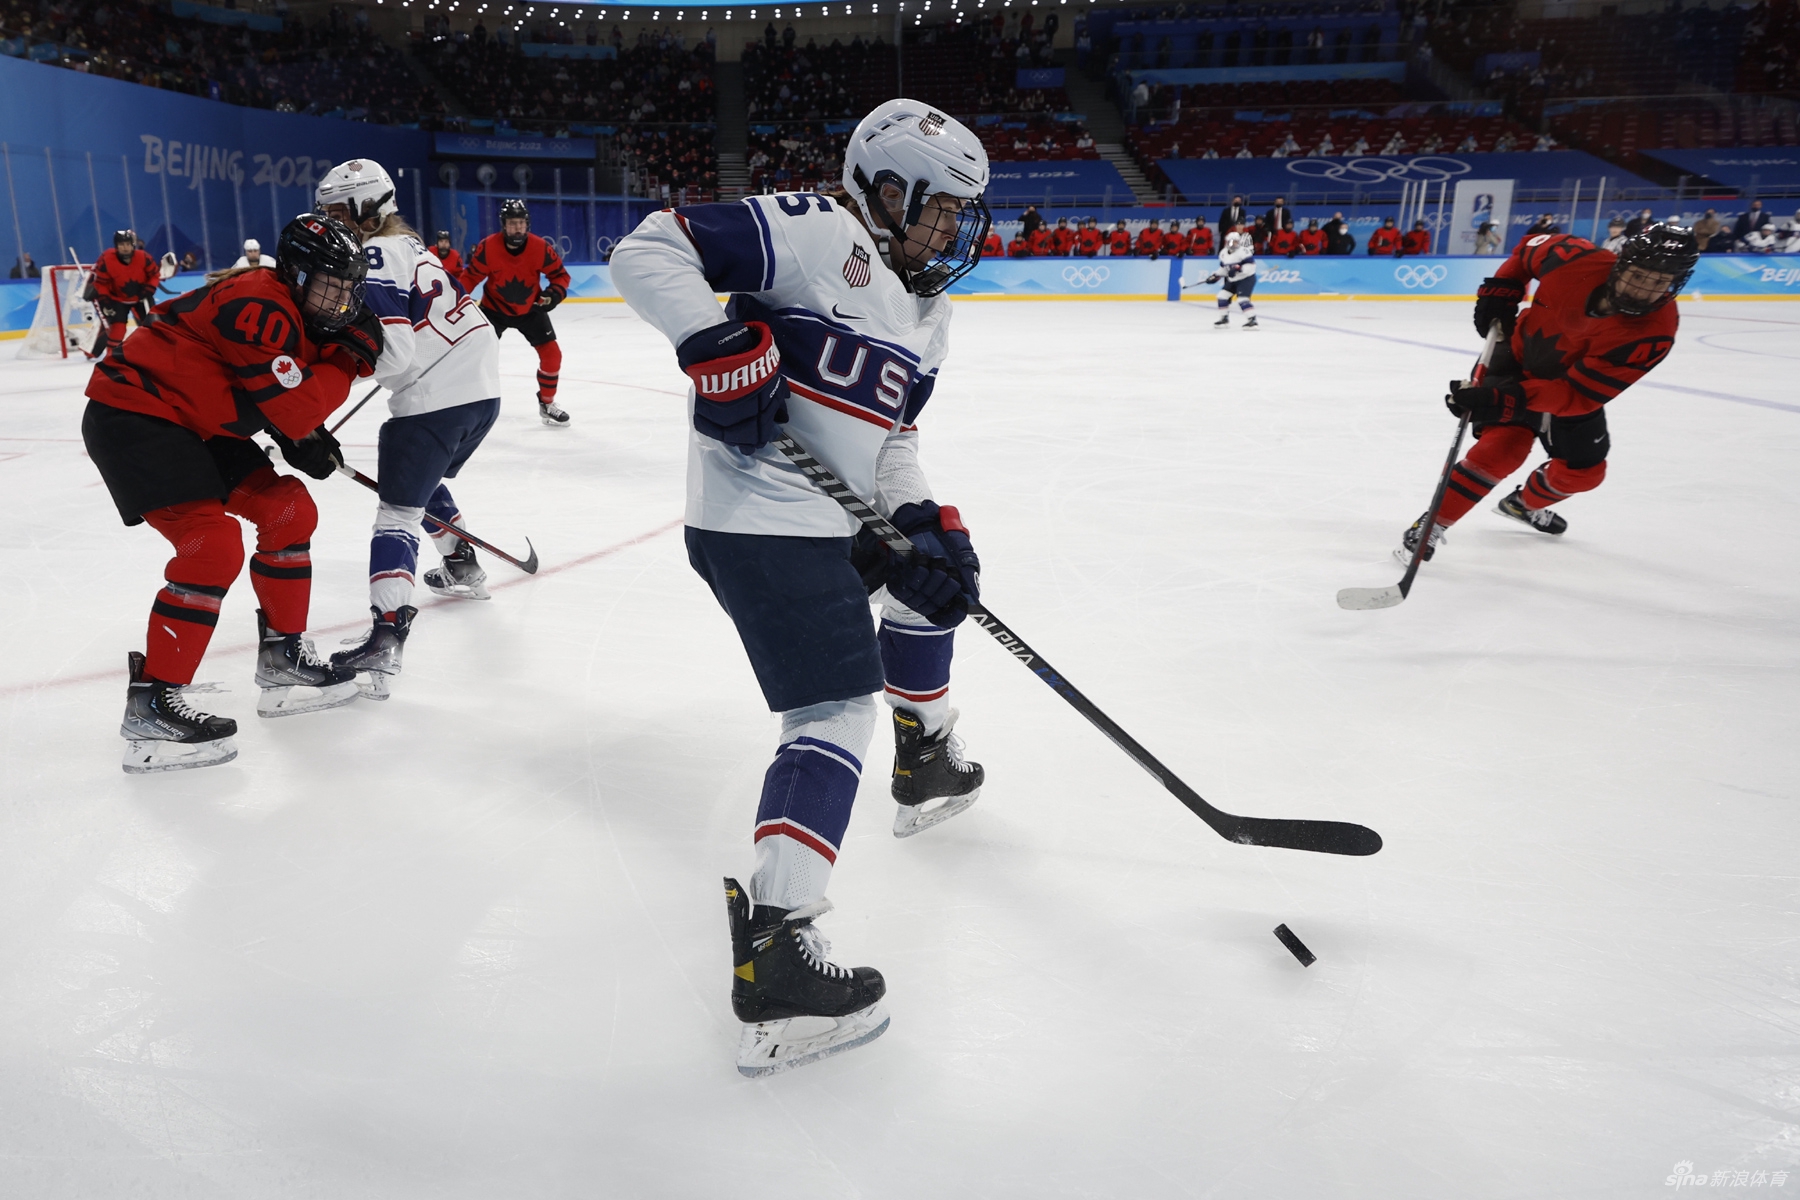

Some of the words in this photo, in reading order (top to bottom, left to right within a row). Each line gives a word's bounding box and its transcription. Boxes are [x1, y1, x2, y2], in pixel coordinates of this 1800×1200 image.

[486, 140, 516, 150] BEIJING
[519, 142, 541, 150] 2022
[140, 134, 245, 190] BEIJING
[364, 245, 385, 270] 8
[854, 246, 868, 262] USA
[1258, 269, 1303, 284] 2022
[414, 260, 490, 346] 2
[234, 302, 291, 350] 40
[1626, 341, 1672, 367] 47
[815, 332, 910, 412] US
[968, 613, 1034, 666] ALPHA
[155, 718, 185, 737] BAUER
